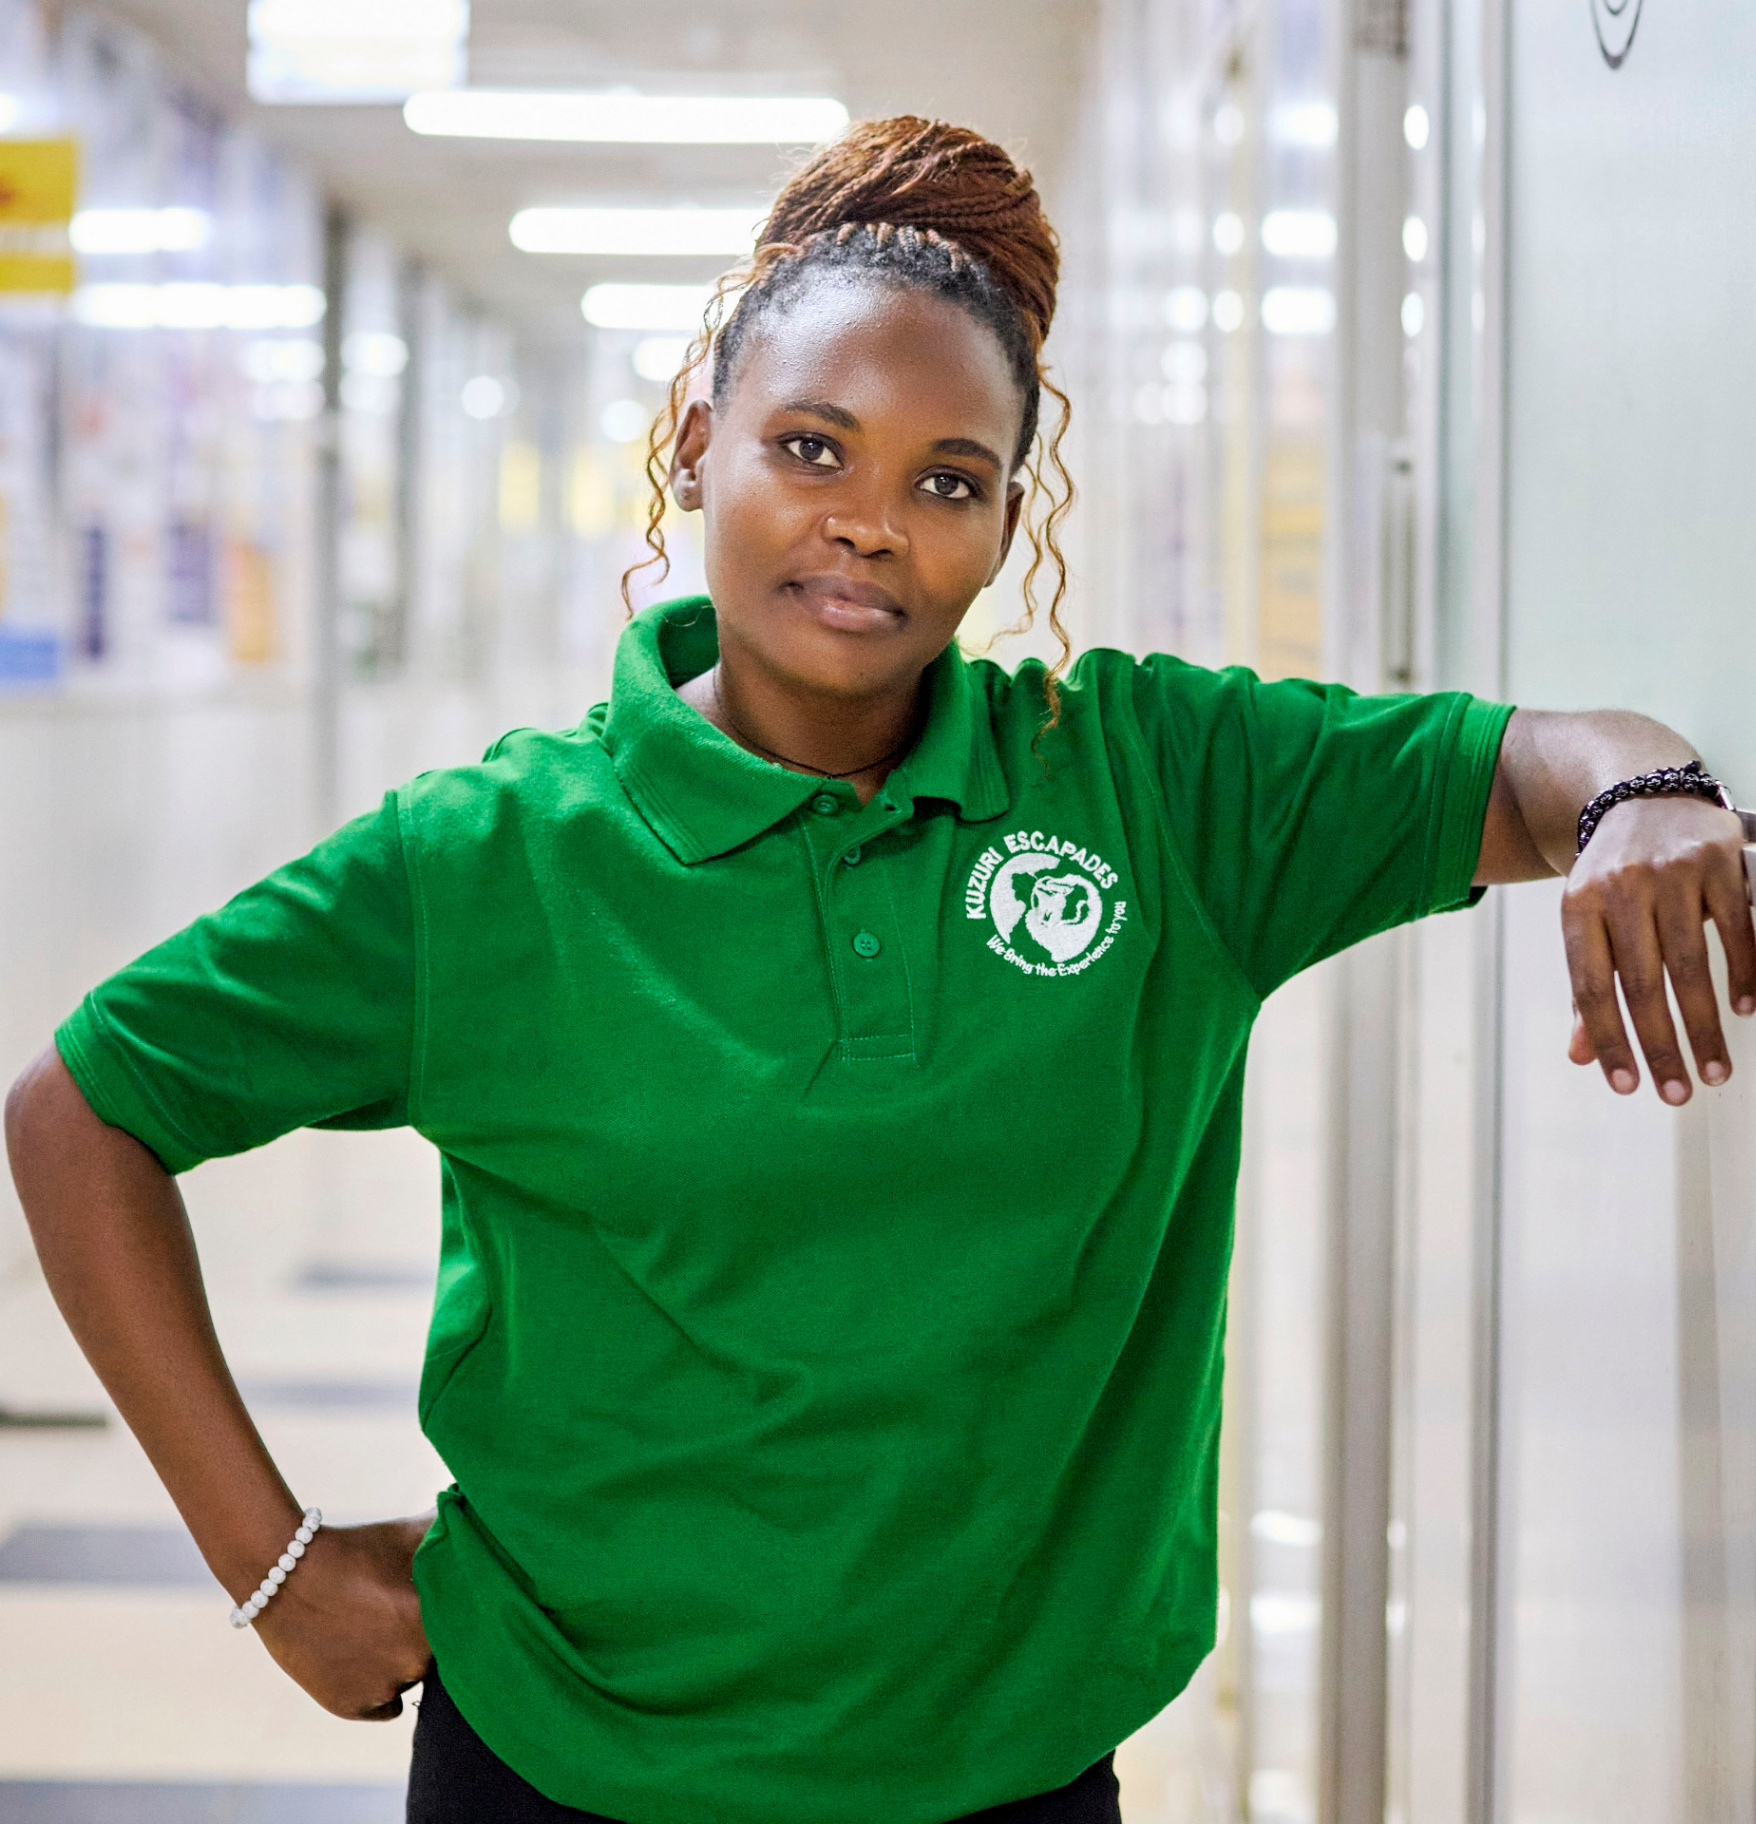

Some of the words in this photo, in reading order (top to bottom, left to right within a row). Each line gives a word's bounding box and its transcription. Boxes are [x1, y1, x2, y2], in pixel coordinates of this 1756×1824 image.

[965, 847, 1004, 919] KUZURI
[1003, 830, 1118, 889] ESCAPADES
[986, 934, 1006, 955] We
[1003, 947, 1033, 975] Bring
[1035, 962, 1057, 977] the
[1057, 932, 1114, 977] Experience
[1105, 922, 1121, 934] to
[1113, 901, 1128, 921] you
